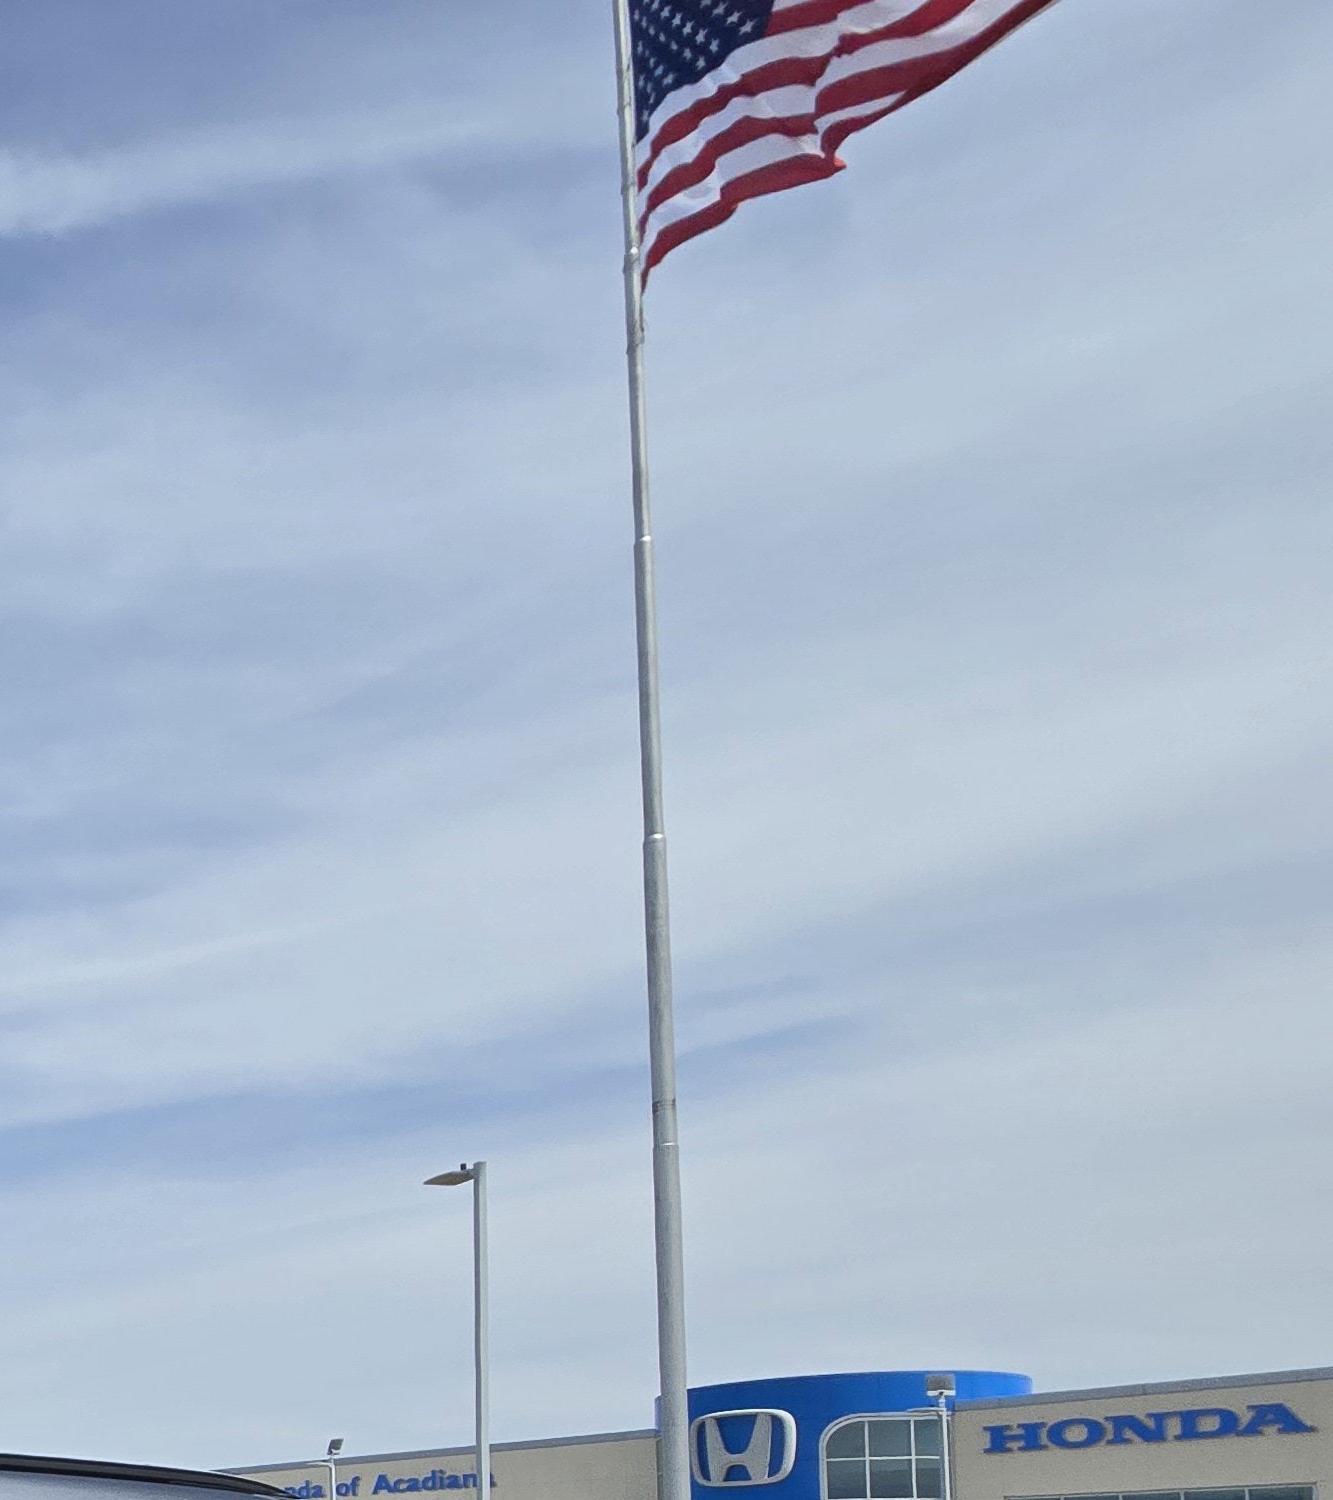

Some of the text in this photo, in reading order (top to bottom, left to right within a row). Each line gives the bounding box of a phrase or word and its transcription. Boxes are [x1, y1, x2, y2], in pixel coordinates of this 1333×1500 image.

[982, 1402, 1317, 1454] HONDA
[284, 1480, 325, 1499] nda
[336, 1475, 360, 1497] of
